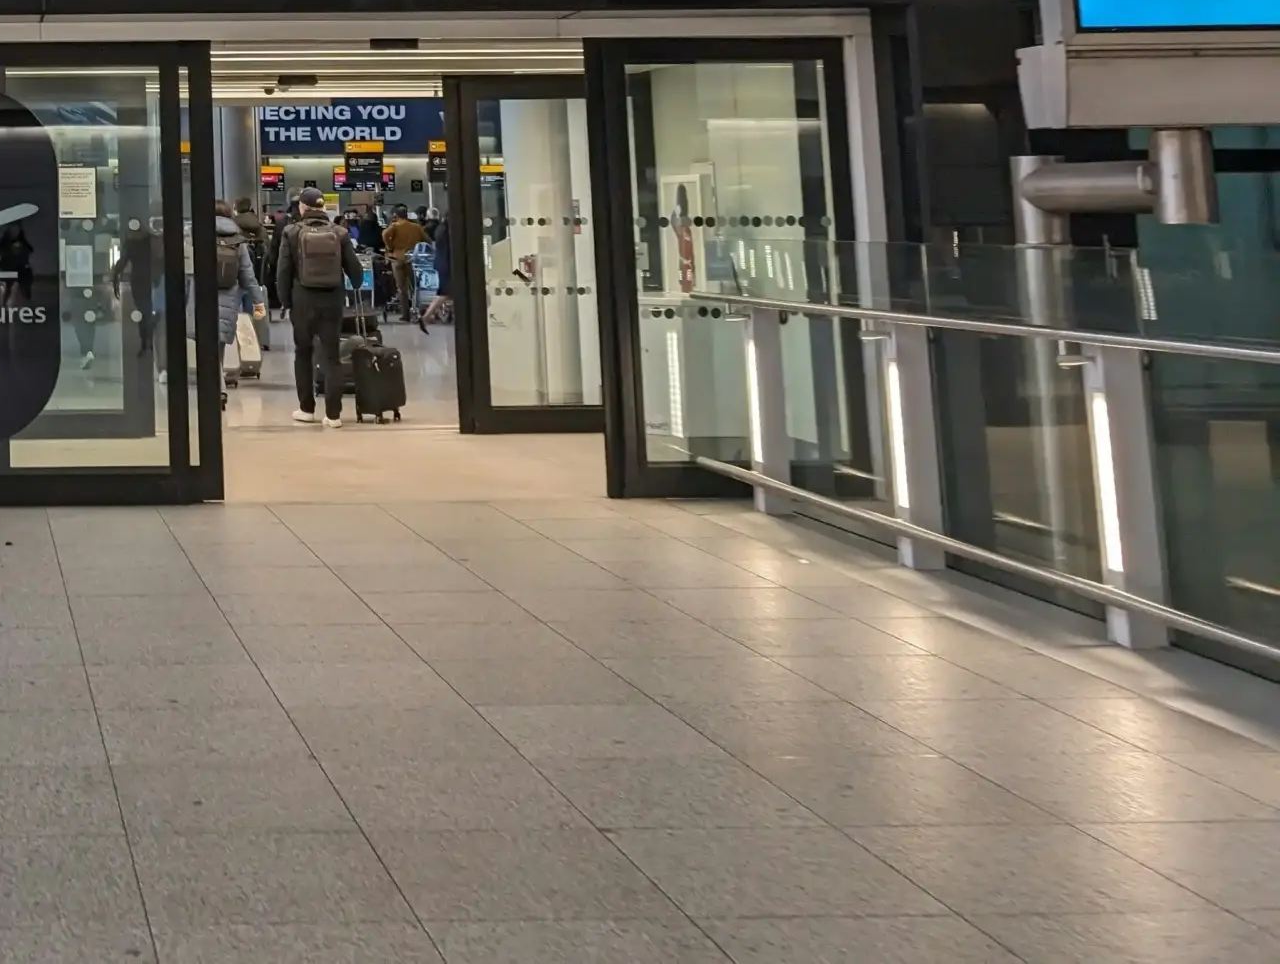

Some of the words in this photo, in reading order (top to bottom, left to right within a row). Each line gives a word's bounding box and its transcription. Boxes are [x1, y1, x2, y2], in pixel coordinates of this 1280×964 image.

[356, 105, 406, 120] YOU
[264, 127, 312, 141] THE
[317, 126, 402, 142] WORLD
